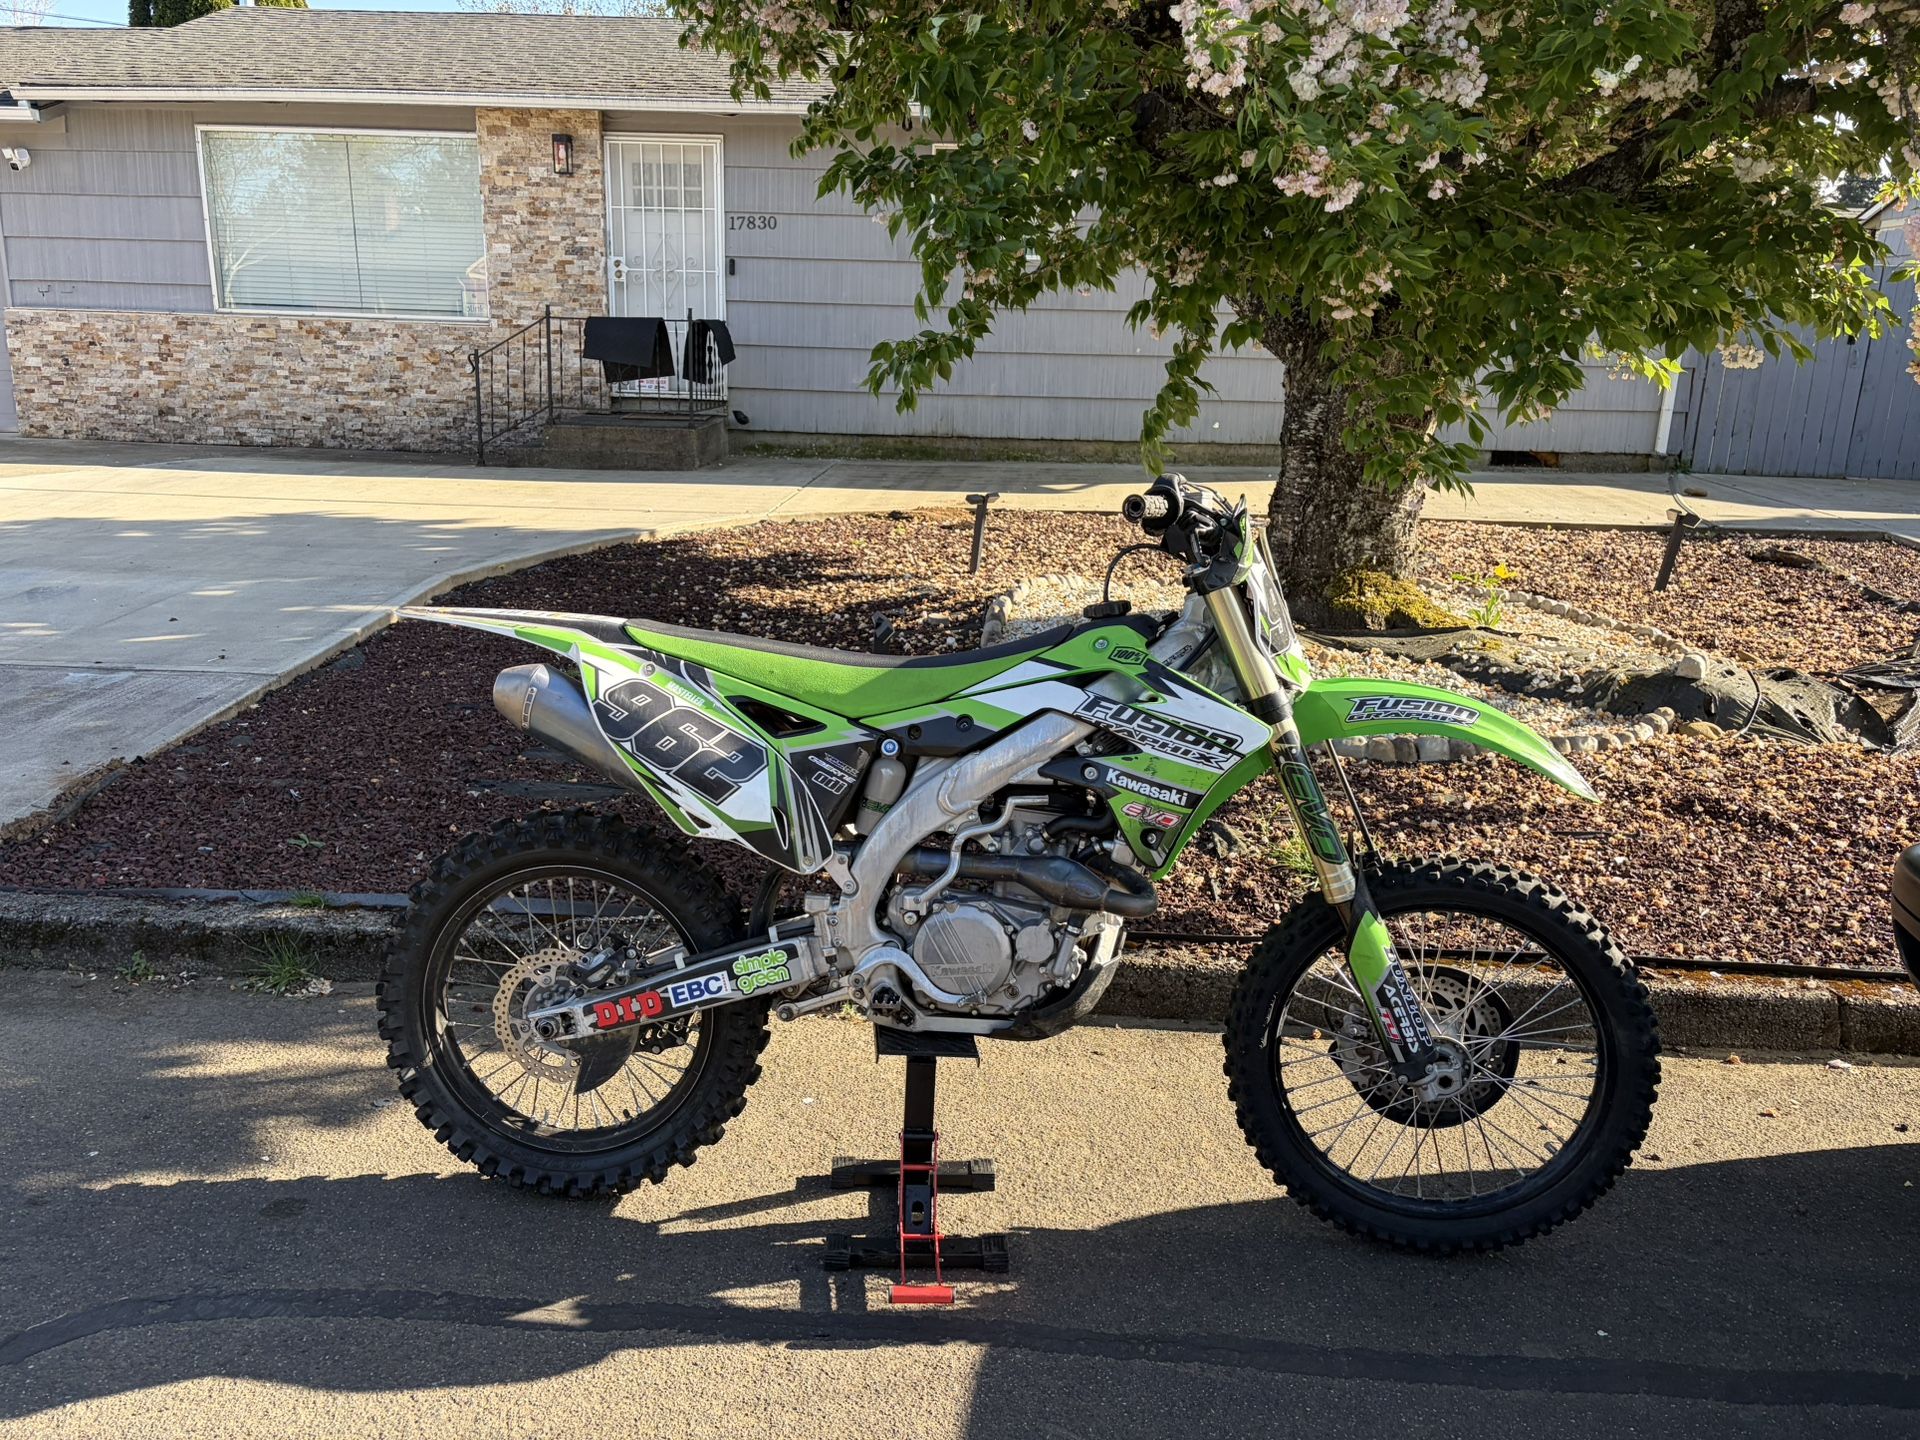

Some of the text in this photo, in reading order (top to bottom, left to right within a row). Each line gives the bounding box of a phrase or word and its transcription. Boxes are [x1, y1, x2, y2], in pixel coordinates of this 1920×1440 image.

[729, 215, 778, 230] 17830
[1113, 648, 1143, 662] 100%
[1350, 696, 1478, 721] FUSION
[592, 678, 769, 805] 962
[1105, 767, 1189, 806] Kawasaki
[732, 948, 788, 976] simple
[670, 974, 724, 1005] EBC
[737, 966, 791, 994] green
